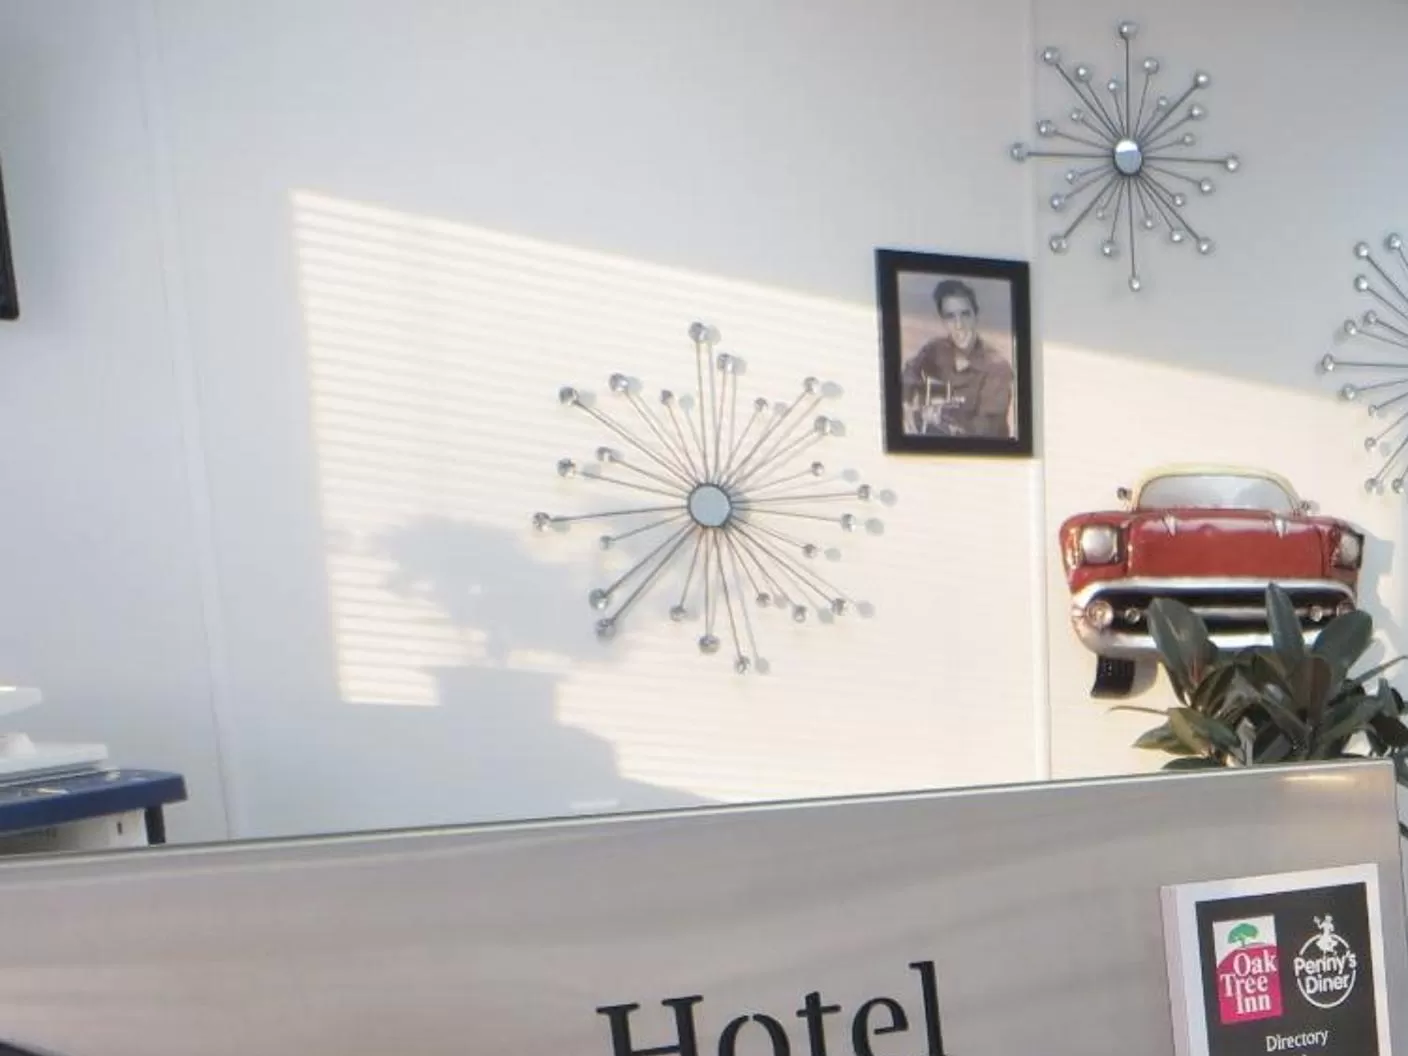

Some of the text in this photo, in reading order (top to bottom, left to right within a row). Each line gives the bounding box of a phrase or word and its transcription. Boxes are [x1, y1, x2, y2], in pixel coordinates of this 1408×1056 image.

[1233, 949, 1278, 977] Oak
[1293, 951, 1357, 977] Penny's
[1219, 974, 1268, 998] Tree
[1304, 974, 1350, 995] Diner
[1235, 993, 1272, 1015] Inn
[1265, 1030, 1329, 1052] Directory
